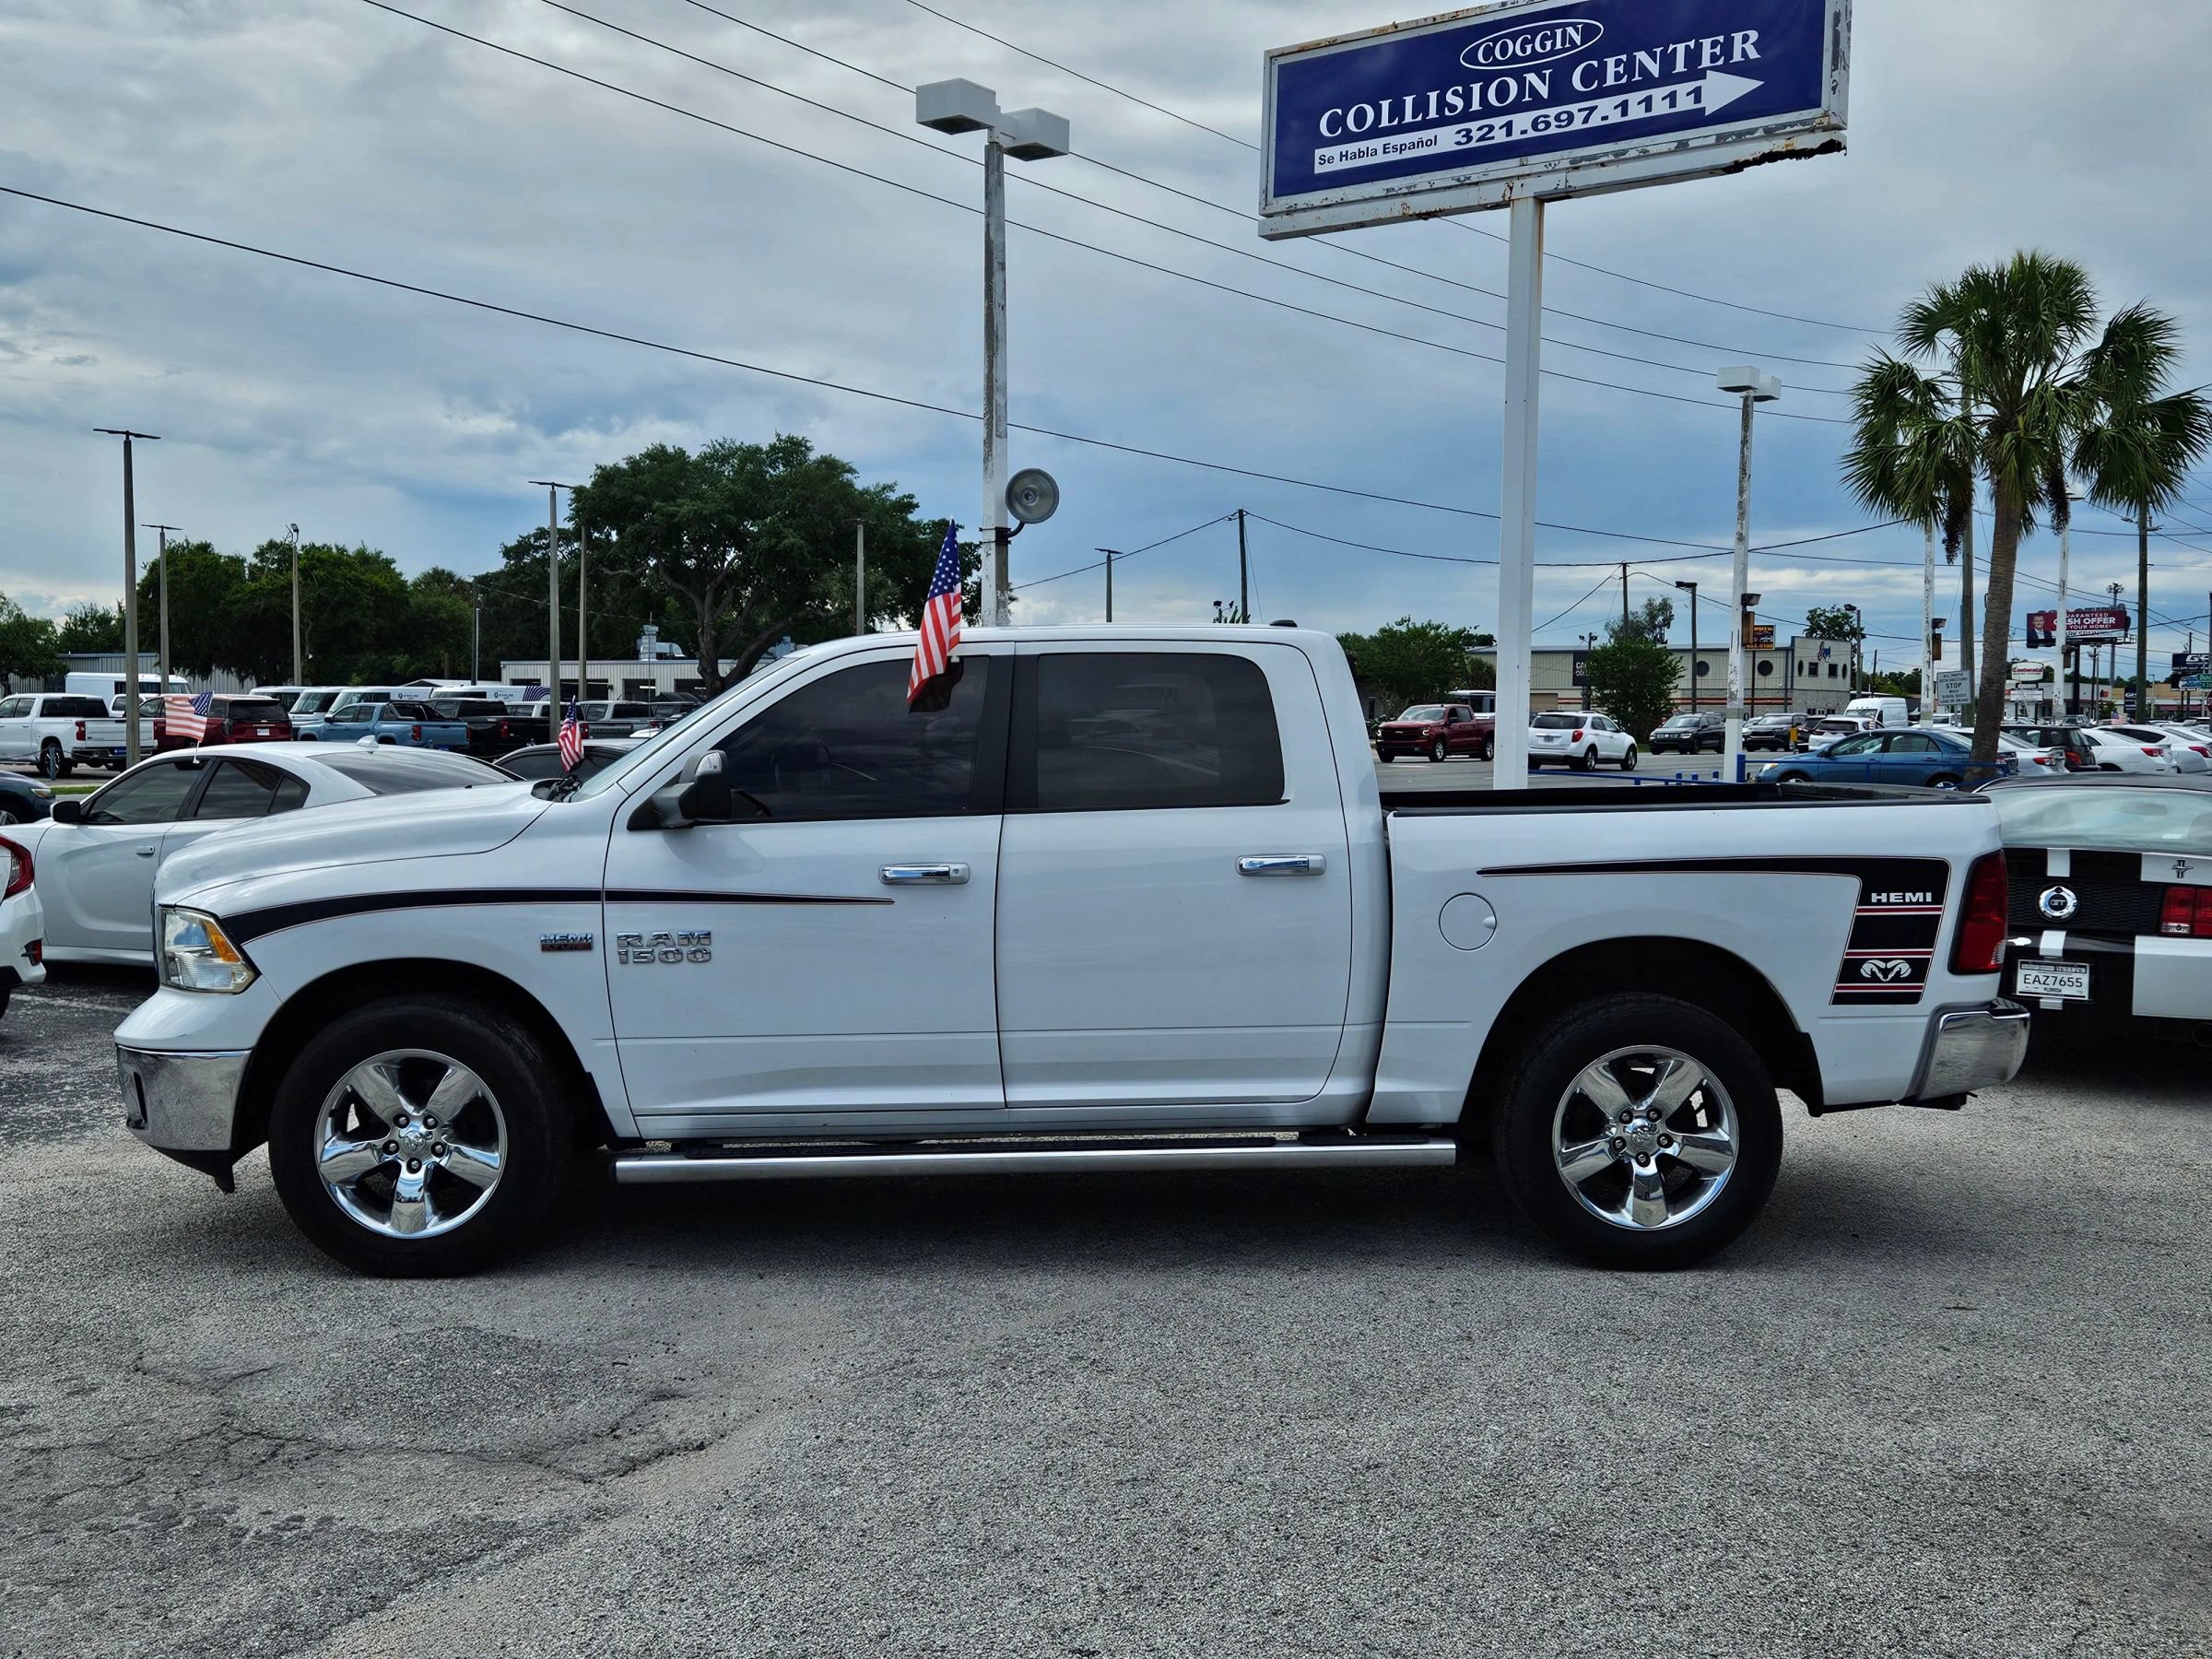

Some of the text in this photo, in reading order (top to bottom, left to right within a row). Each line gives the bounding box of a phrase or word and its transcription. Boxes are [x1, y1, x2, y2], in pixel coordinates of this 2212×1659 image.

[1477, 24, 1583, 65] COGGIN
[1318, 29, 1762, 137] COLLISION CENTER
[1318, 85, 1703, 166] Se Habla Español 321.697.1111
[2083, 617, 2116, 625] OFFER
[1870, 891, 1933, 903] HEMI
[617, 930, 712, 947] RAM
[617, 947, 712, 965] 1500
[2023, 973, 2083, 988] EAZ7655
